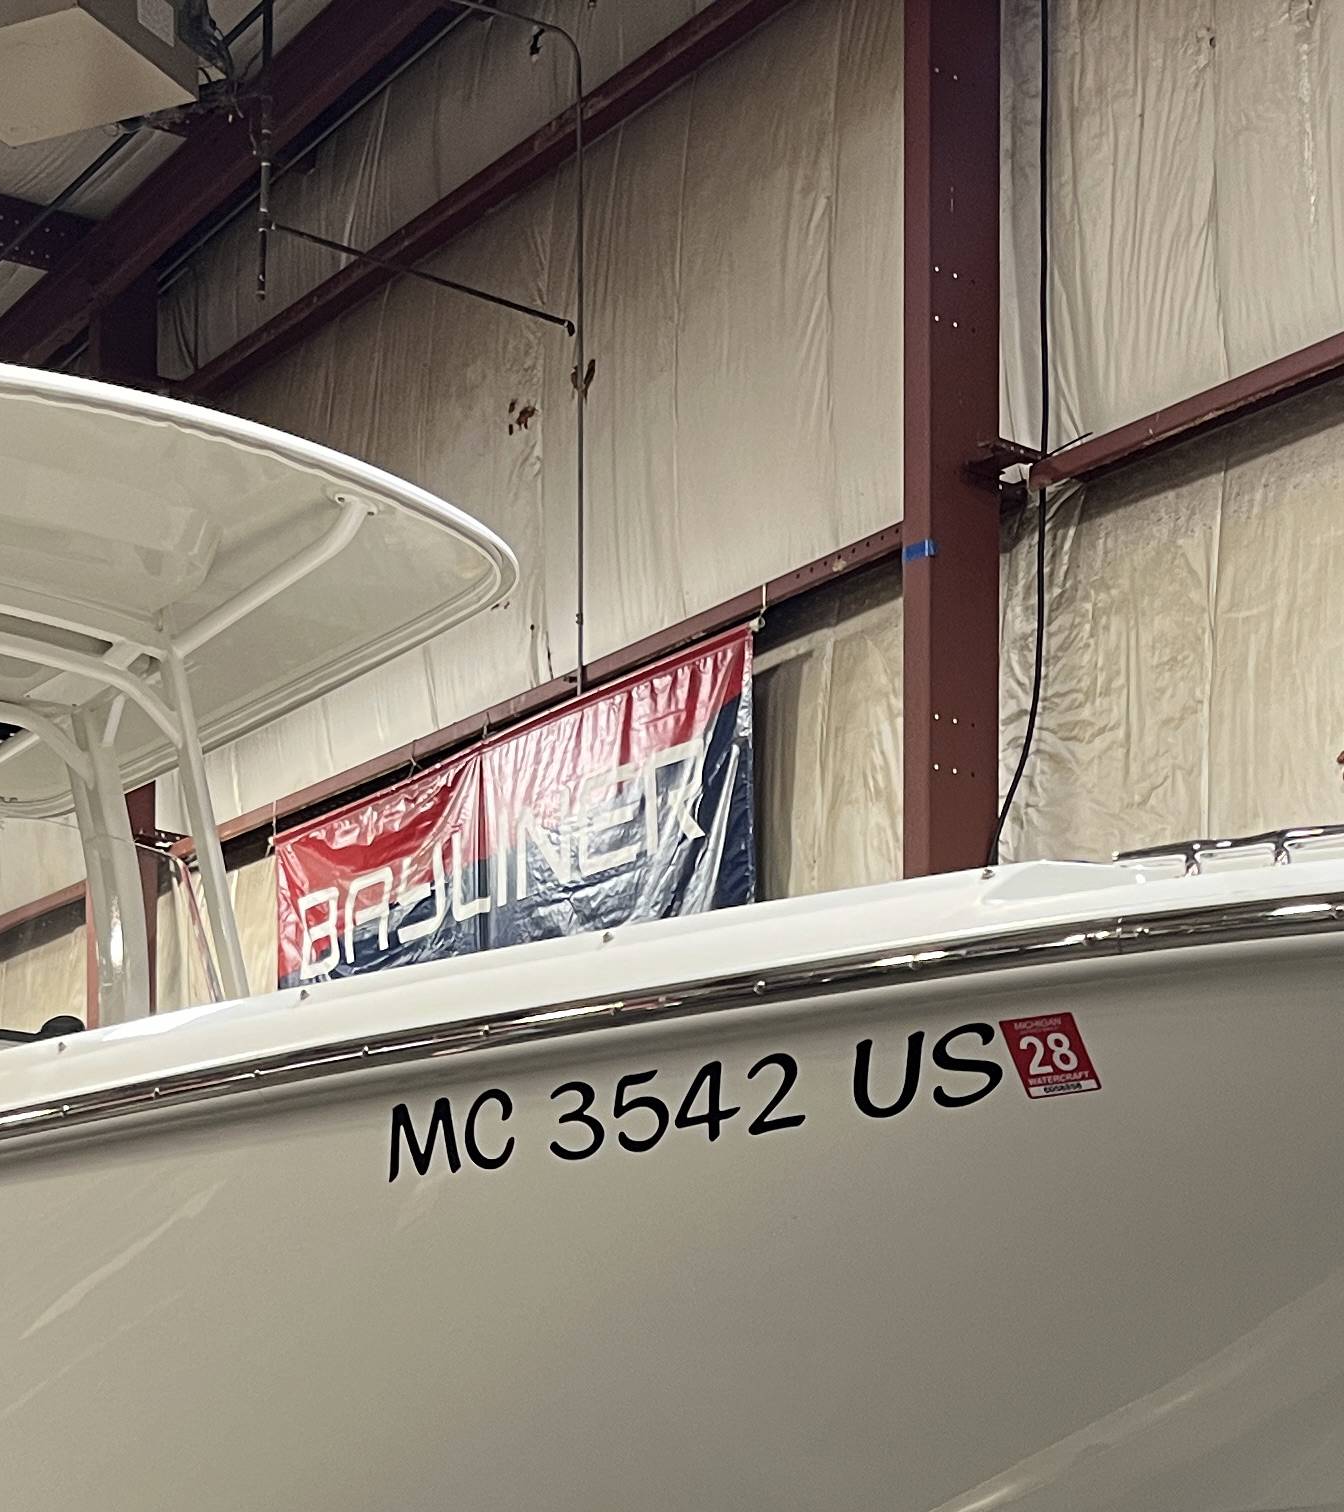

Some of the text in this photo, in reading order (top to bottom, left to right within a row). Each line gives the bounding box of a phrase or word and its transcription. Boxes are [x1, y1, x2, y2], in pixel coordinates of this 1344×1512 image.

[298, 738, 705, 981] BAYLINER
[388, 1022, 1004, 1184] MC 3542 US
[1019, 1032, 1078, 1076] 28
